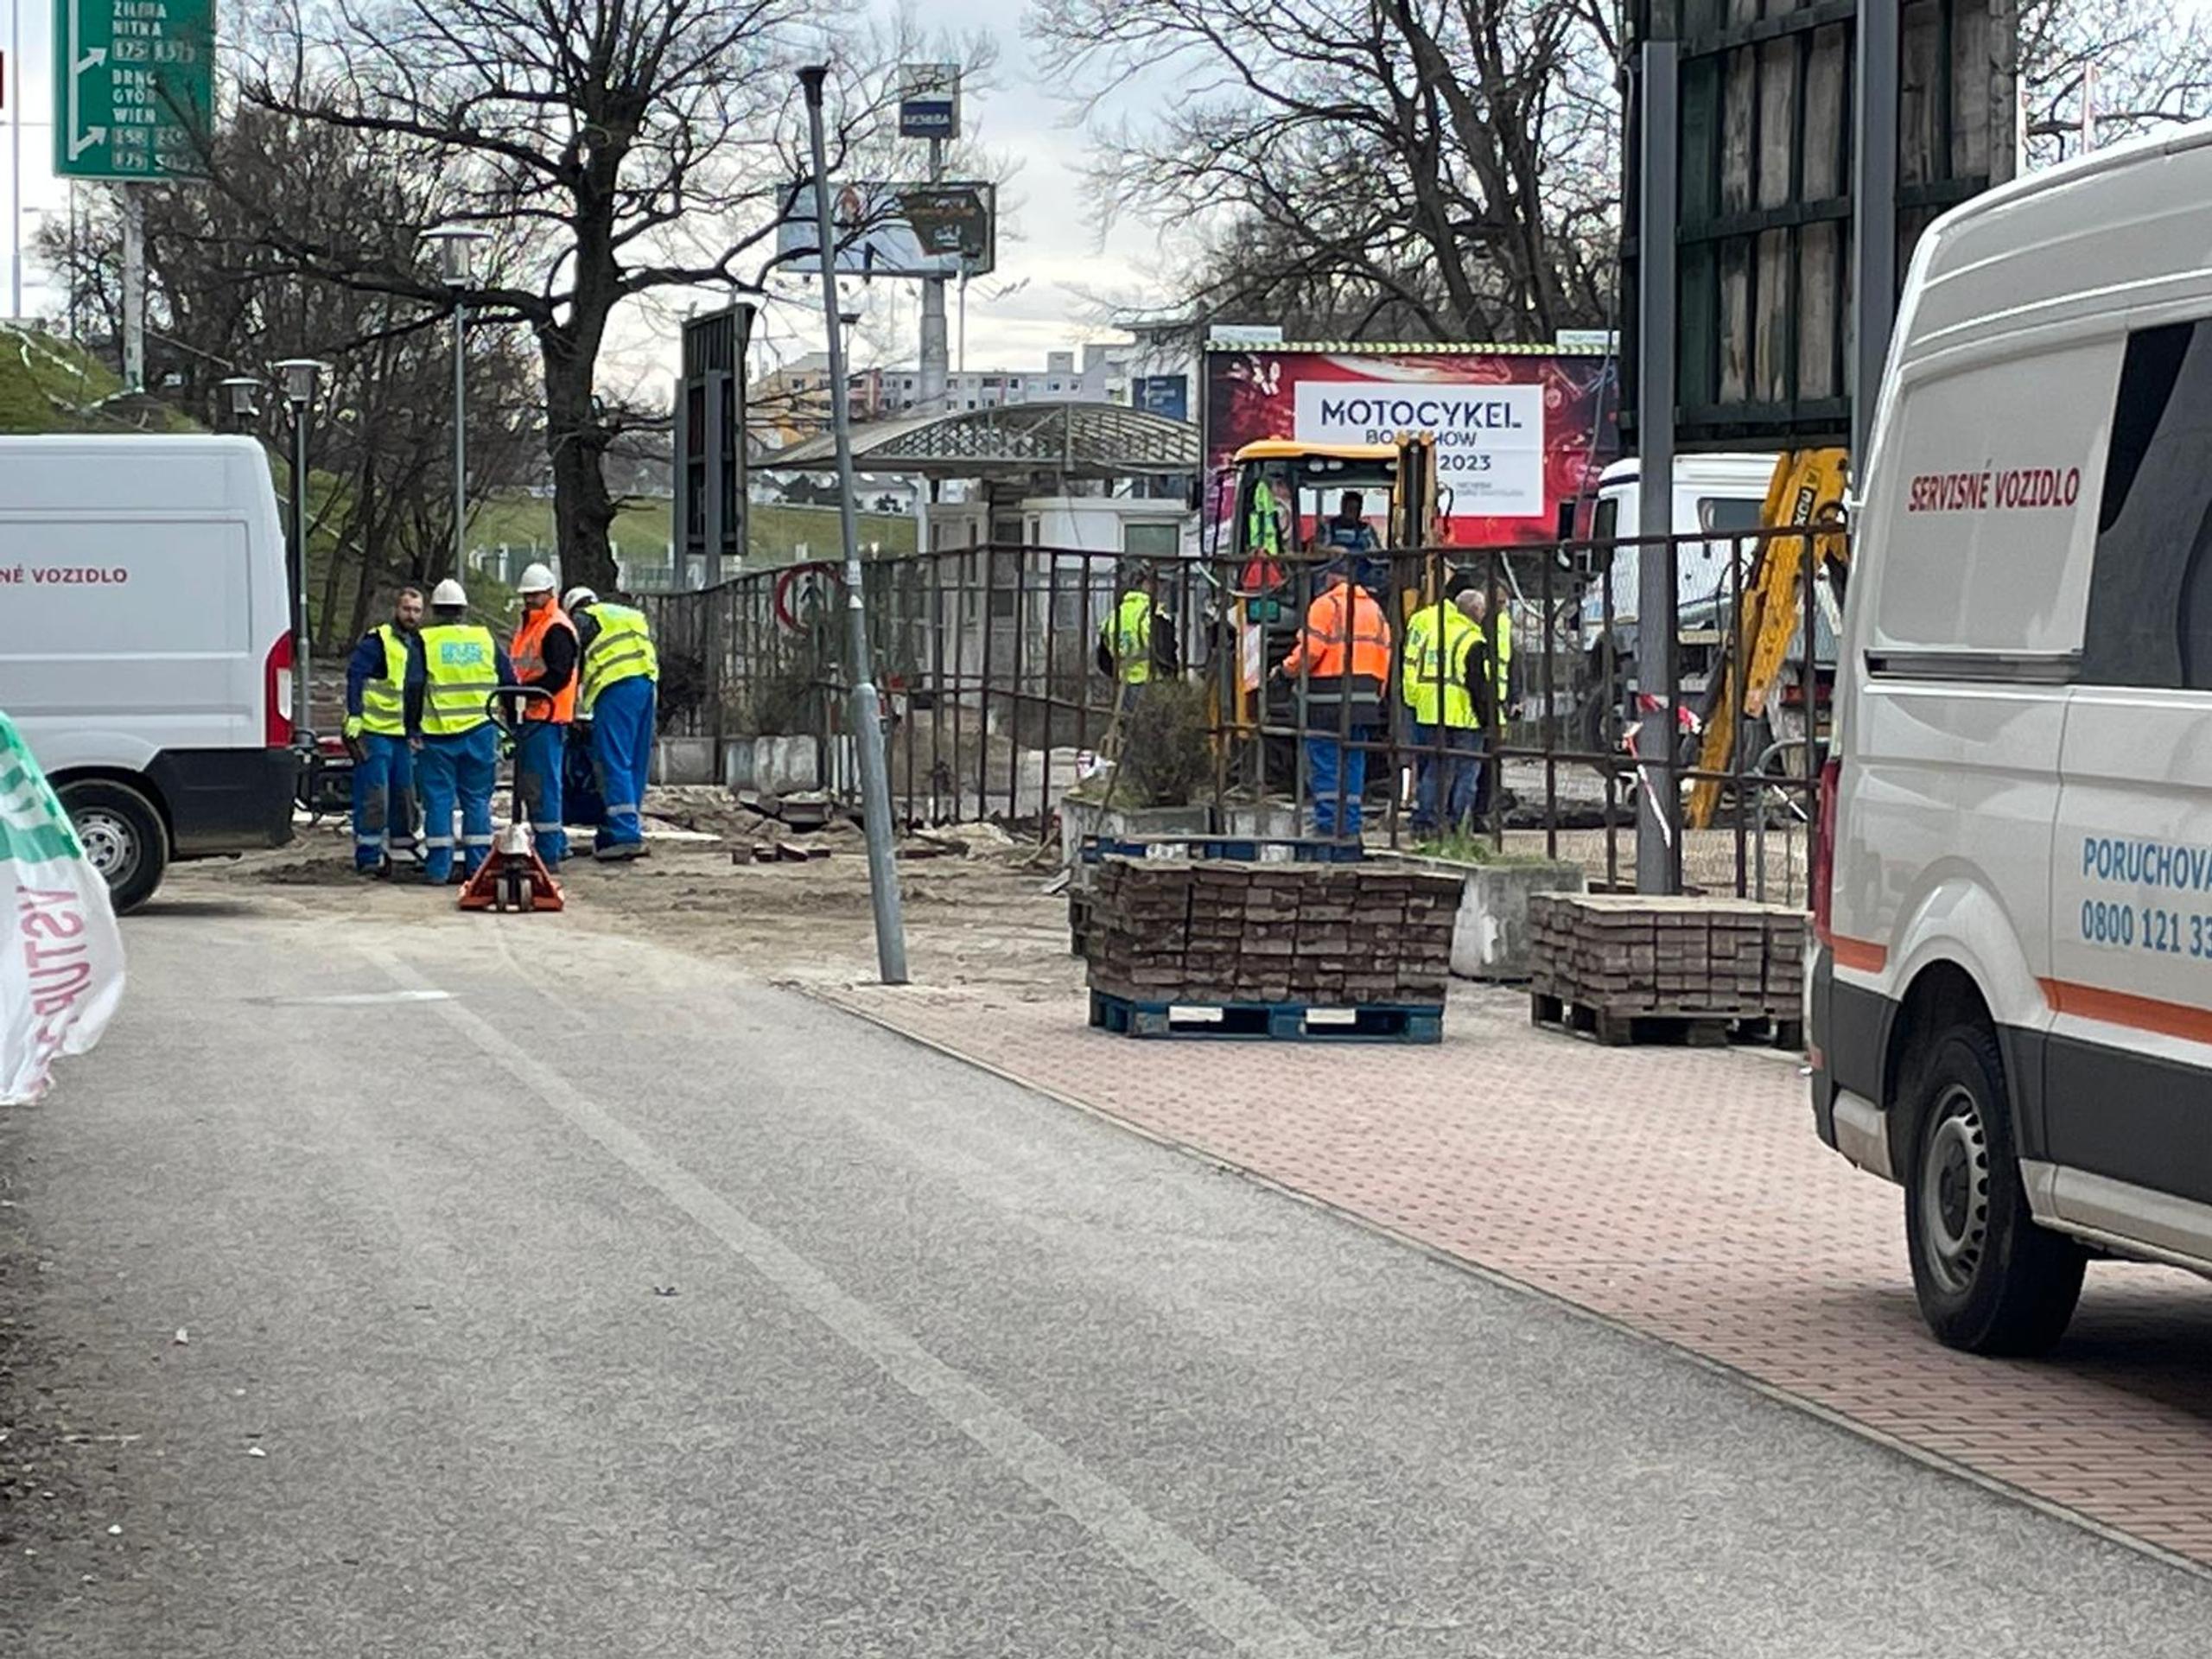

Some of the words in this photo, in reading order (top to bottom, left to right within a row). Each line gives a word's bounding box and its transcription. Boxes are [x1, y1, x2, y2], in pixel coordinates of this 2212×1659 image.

[1321, 398, 1522, 429] MOTOCYKEL
[1440, 454, 1491, 471] 2023
[1909, 459, 1992, 512] SERVISNÉ
[1995, 467, 2080, 508] VOZIDLO
[32, 568, 128, 583] VOZIDLO
[2082, 899, 2134, 946] 0800
[2142, 907, 2182, 953] 121
